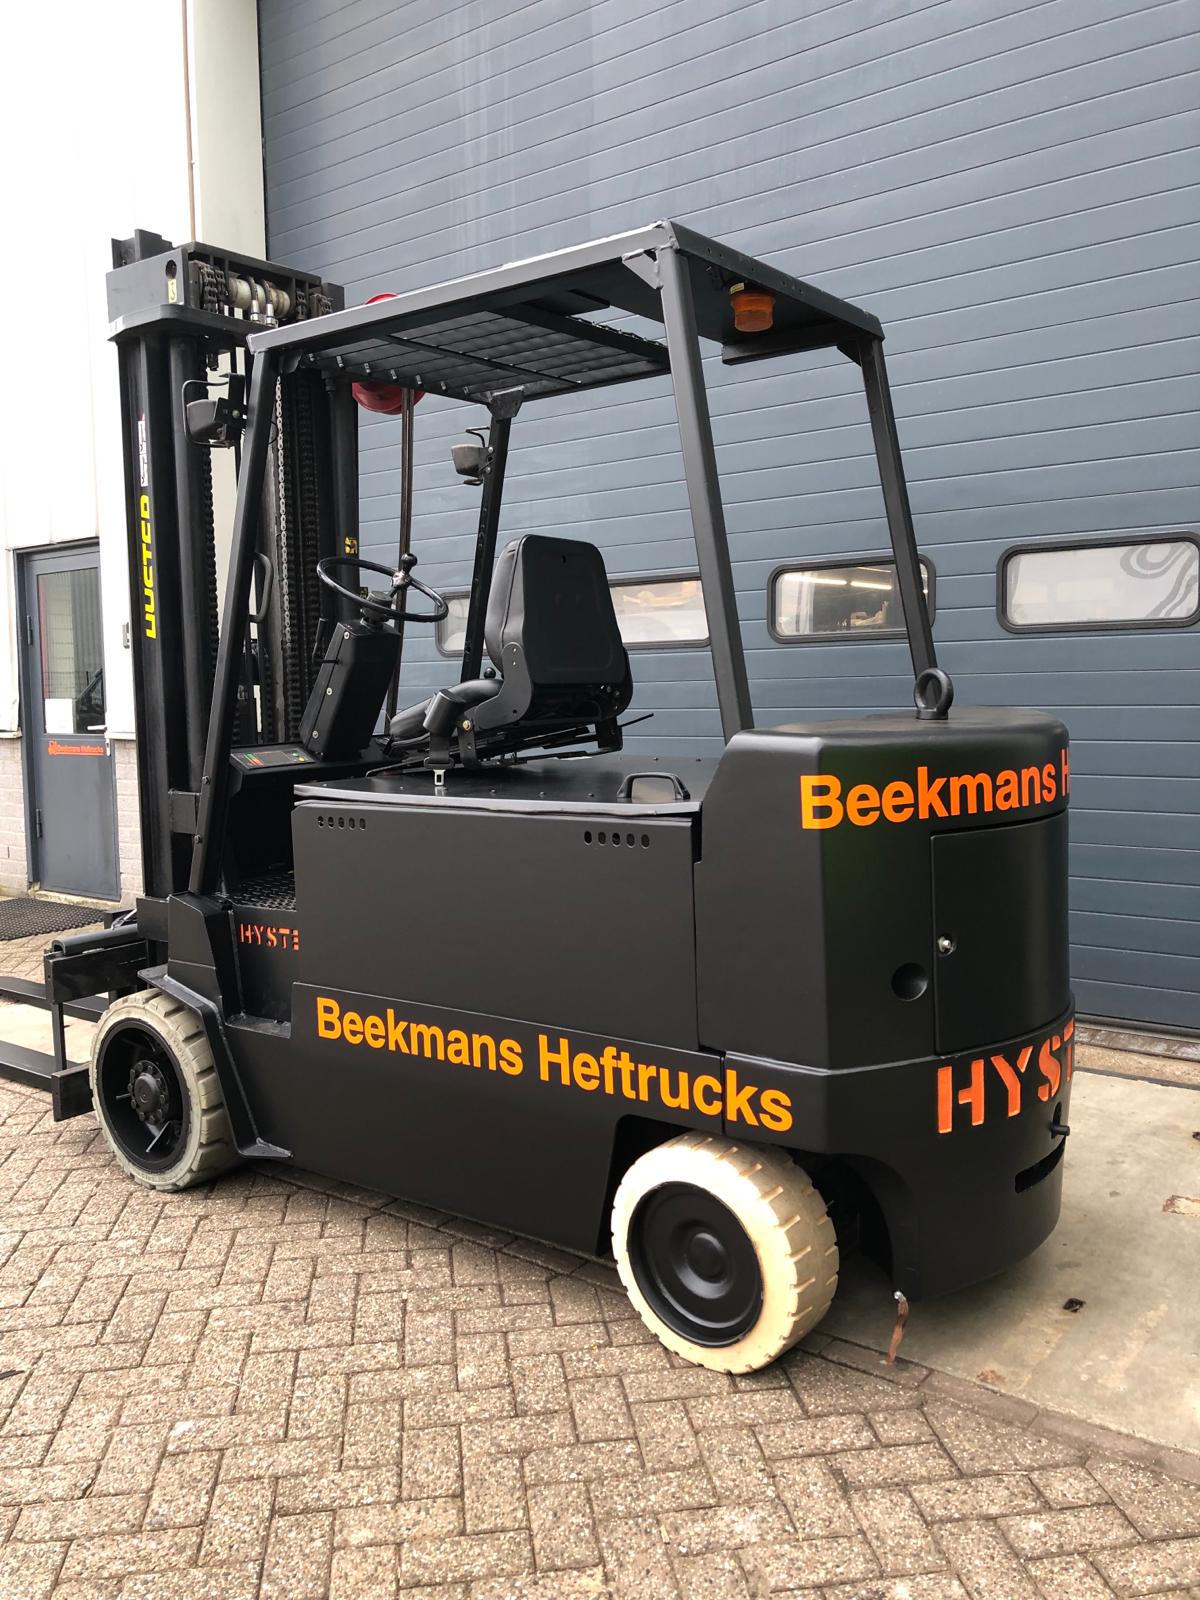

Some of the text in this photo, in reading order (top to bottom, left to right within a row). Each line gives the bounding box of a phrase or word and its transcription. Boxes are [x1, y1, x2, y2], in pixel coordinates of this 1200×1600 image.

[800, 763, 1057, 830] Beekmans
[316, 996, 793, 1132] Beekmans Heftrucks
